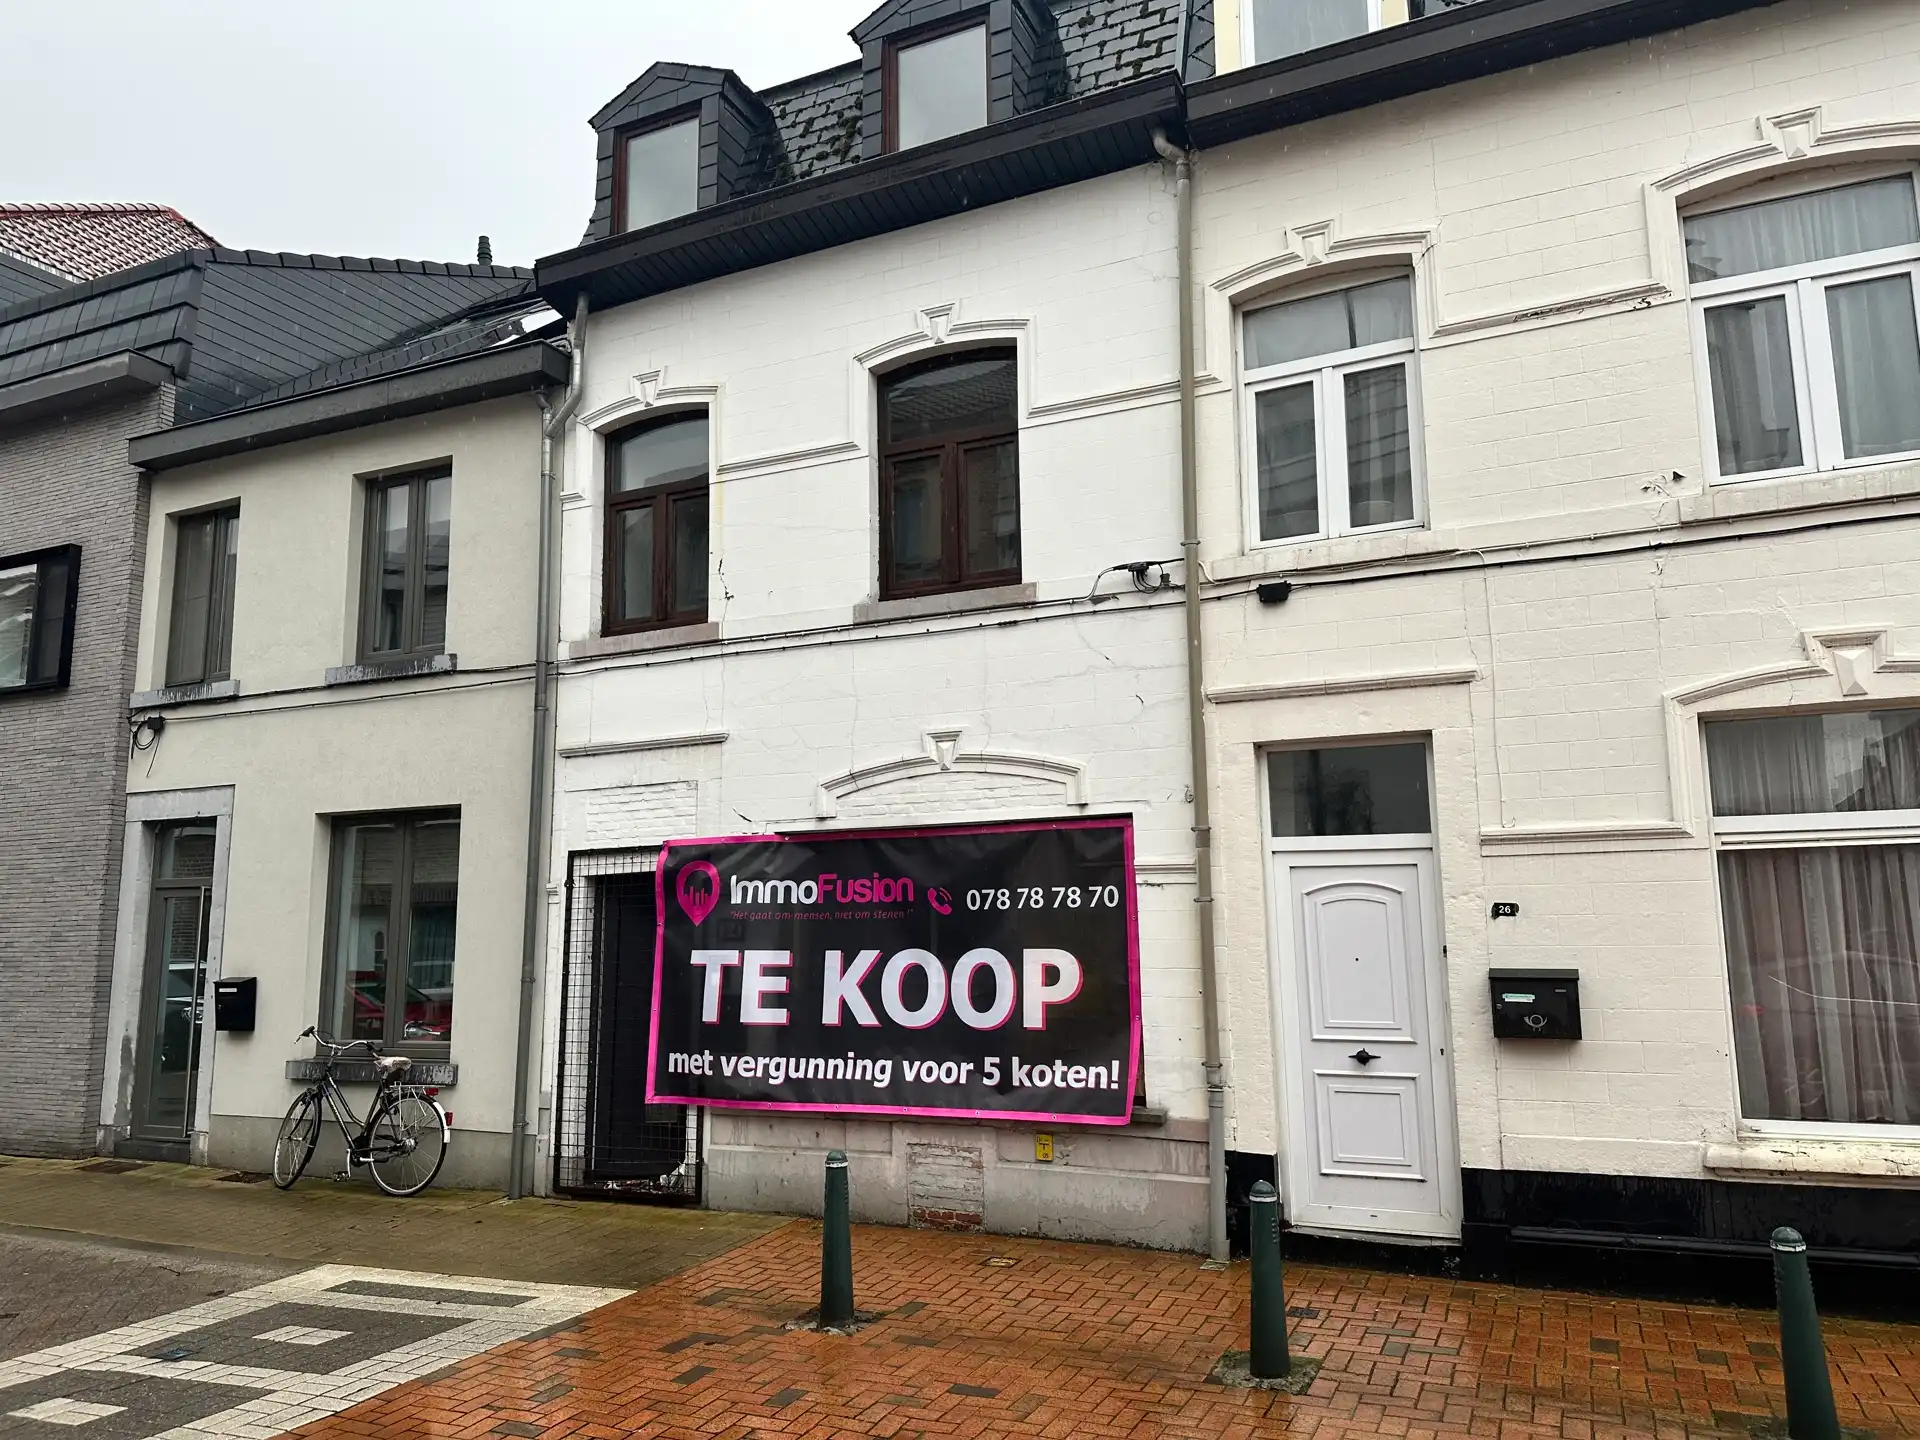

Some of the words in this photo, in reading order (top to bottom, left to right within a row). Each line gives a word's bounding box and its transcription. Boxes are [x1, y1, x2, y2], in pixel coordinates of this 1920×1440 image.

[731, 872, 915, 905] ImmoFusion
[966, 888, 1011, 911] 078
[1017, 887, 1044, 909] 78
[1051, 886, 1081, 909] 78
[1088, 885, 1120, 908] 70
[749, 911, 772, 922] gaat
[775, 912, 791, 920] om
[794, 911, 832, 921] mensen,
[835, 910, 852, 919] niet
[855, 911, 871, 919] om
[873, 909, 904, 919] stenen
[1498, 905, 1511, 913] 26
[690, 949, 793, 1025] TE
[821, 947, 1084, 1031] KOOP
[668, 1050, 713, 1076] met
[720, 1051, 893, 1088] vergunning
[902, 1059, 974, 1085] voor
[982, 1056, 1000, 1087] 5
[1011, 1056, 1120, 1089] koten!
